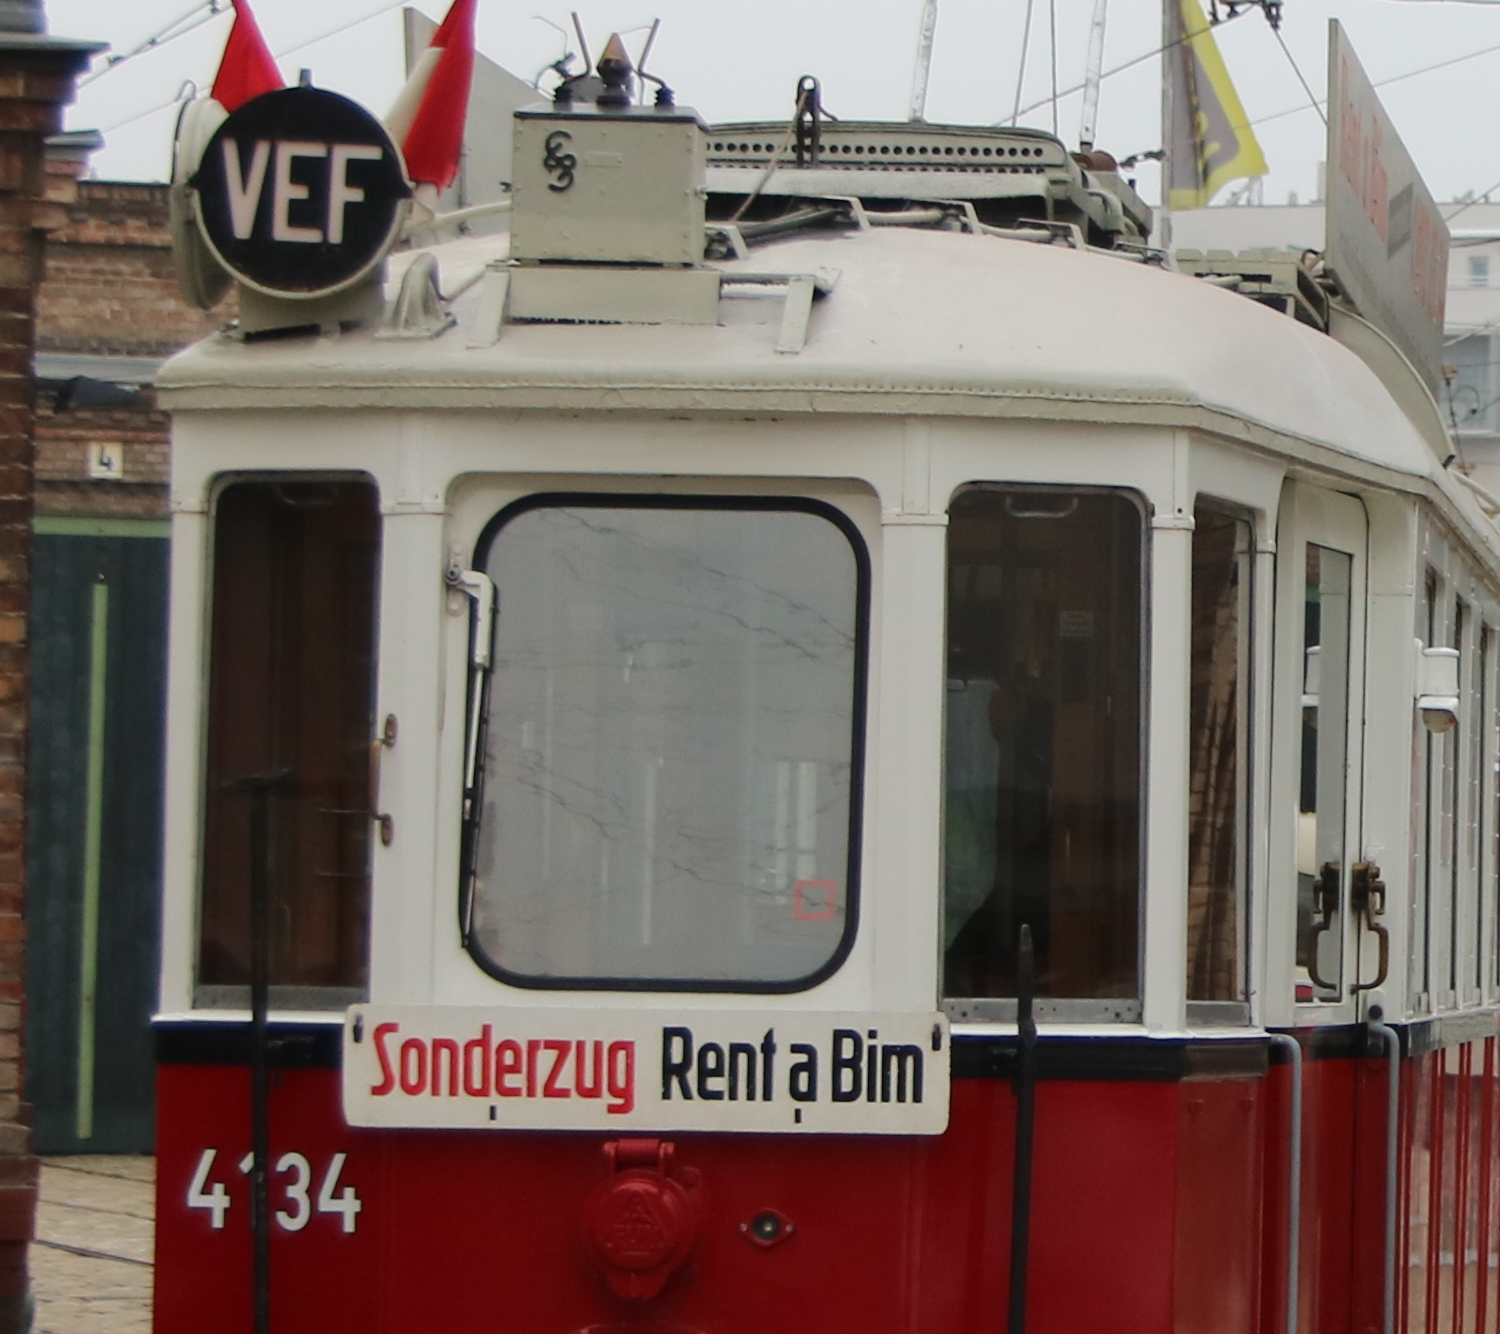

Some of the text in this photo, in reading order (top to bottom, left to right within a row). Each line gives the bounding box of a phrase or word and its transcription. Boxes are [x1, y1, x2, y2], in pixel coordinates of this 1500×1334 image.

[222, 138, 383, 244] VEF
[99, 444, 112, 470] 4
[370, 1021, 924, 1114] Sonderzug Rent a Bim
